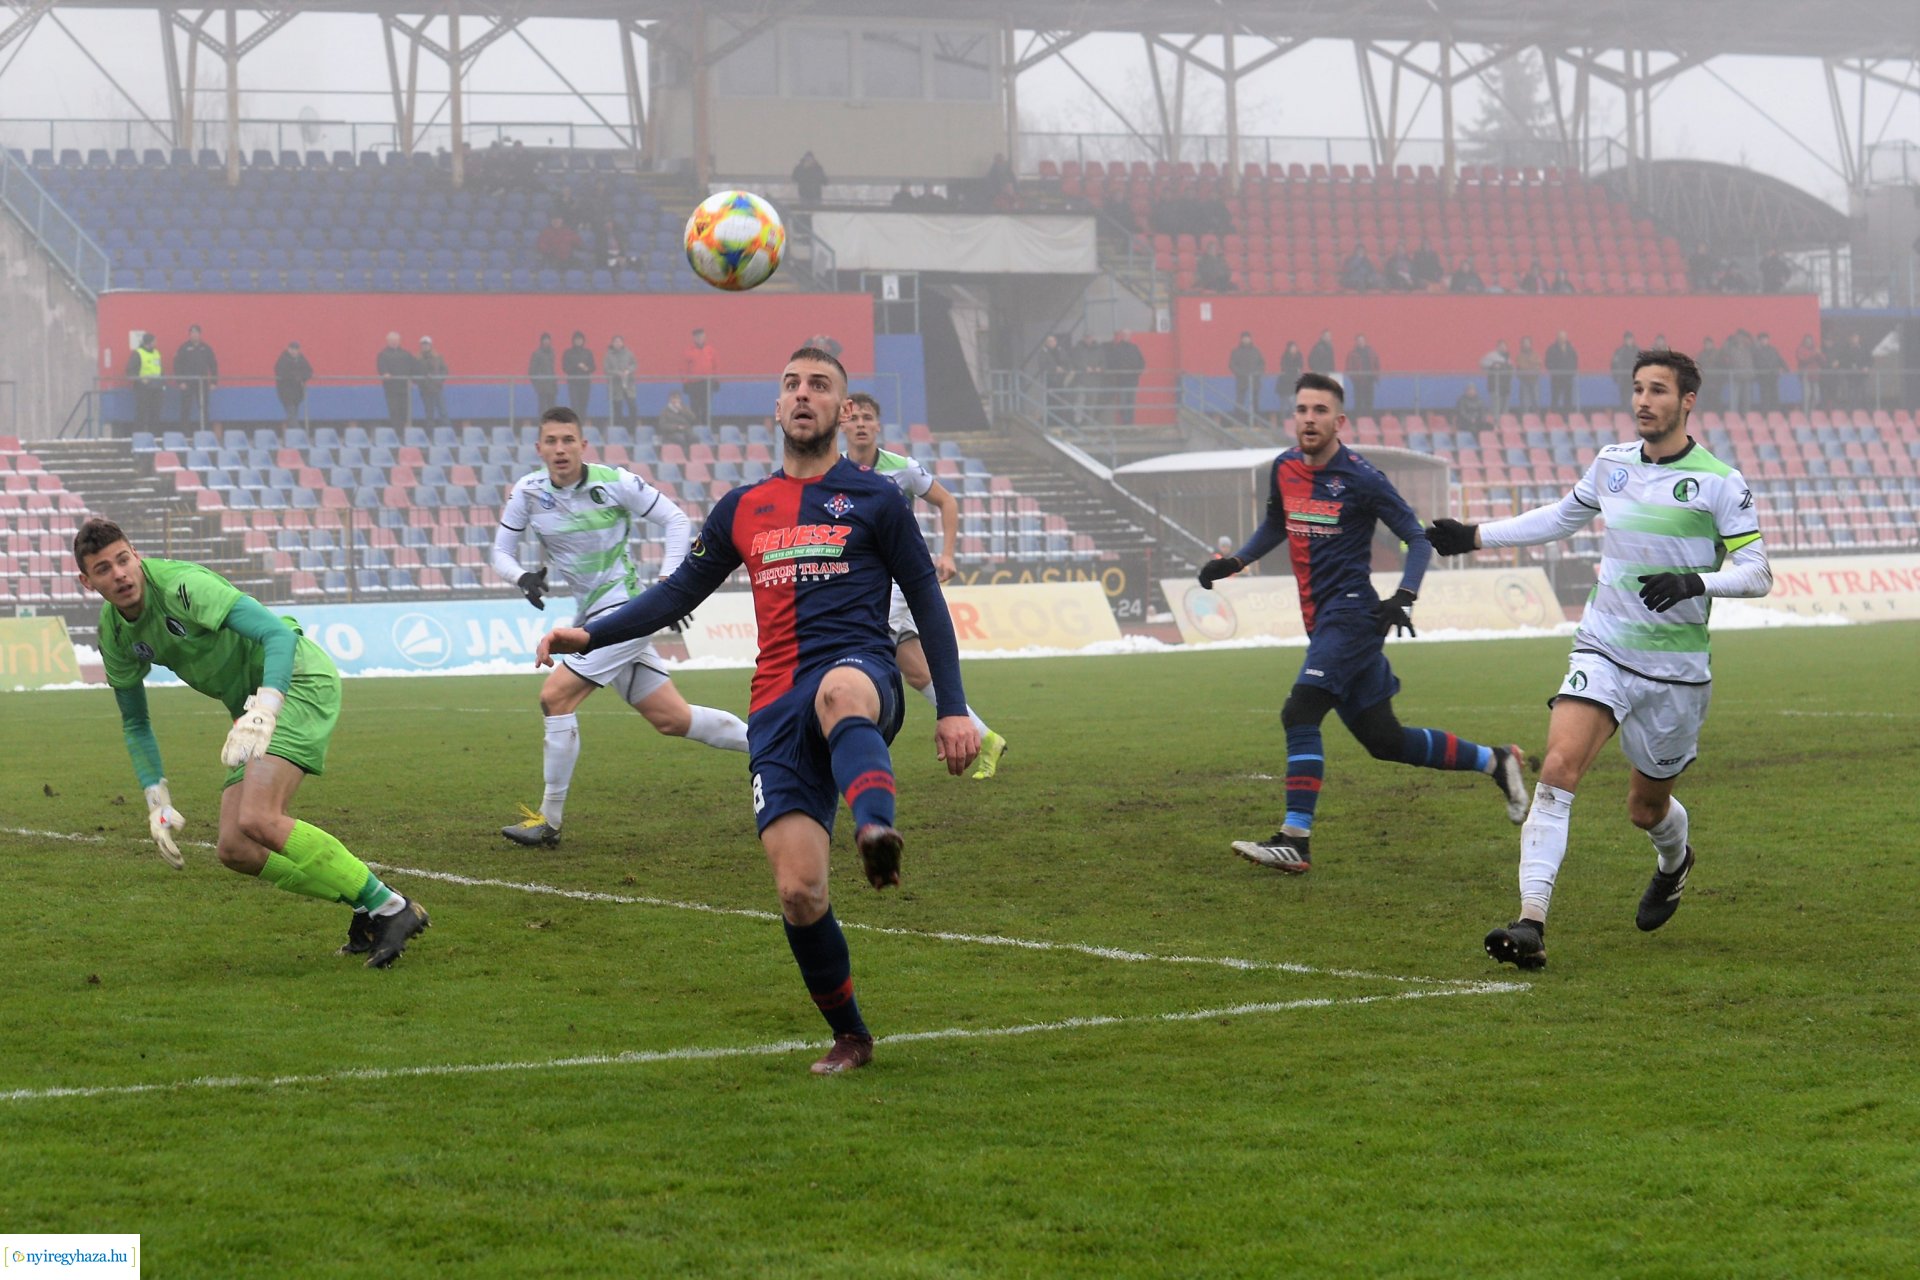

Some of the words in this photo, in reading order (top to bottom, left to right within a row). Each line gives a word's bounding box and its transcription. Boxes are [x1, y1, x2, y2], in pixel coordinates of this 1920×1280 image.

[751, 524, 852, 556] REVESZ
[825, 547, 841, 555] WAY
[799, 562, 849, 575] TRANS
